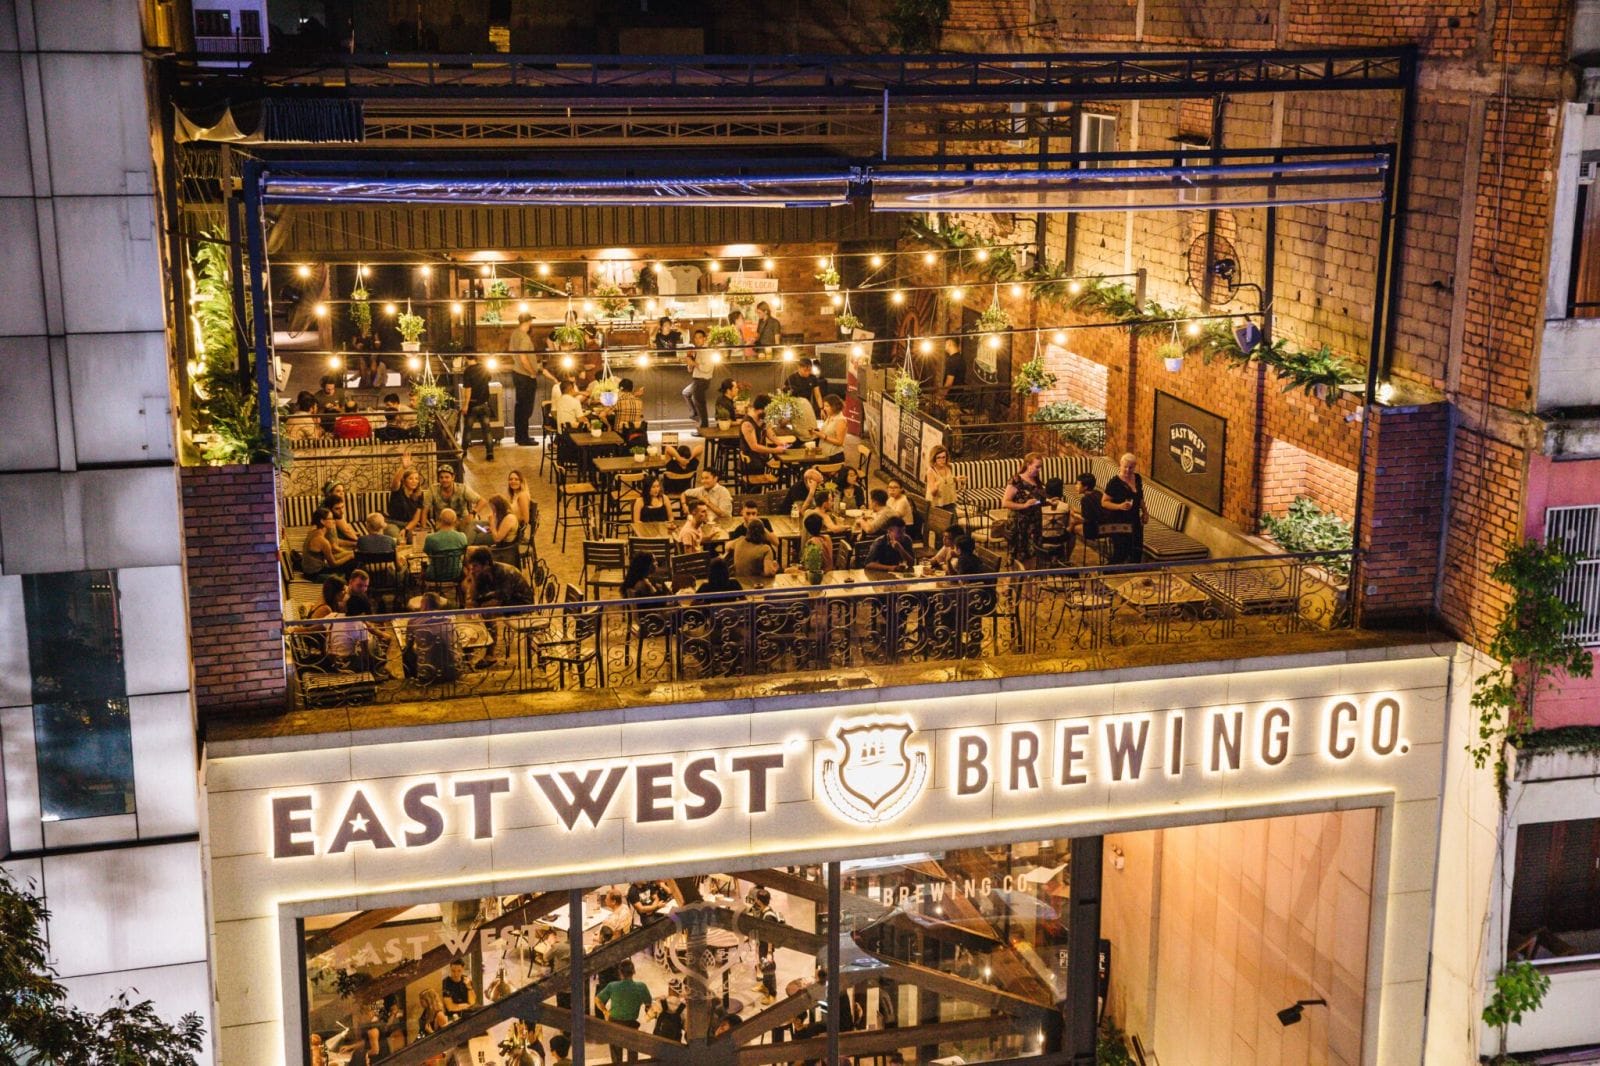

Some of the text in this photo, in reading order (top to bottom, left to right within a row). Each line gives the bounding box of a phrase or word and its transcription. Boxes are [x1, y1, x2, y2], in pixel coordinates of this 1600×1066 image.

[1171, 427, 1187, 440] EAST
[1188, 429, 1206, 453] WEST
[273, 697, 1409, 858] EAST WEST BREWING CO.
[883, 873, 1033, 907] BREWING CO.
[433, 923, 537, 956] WEST
